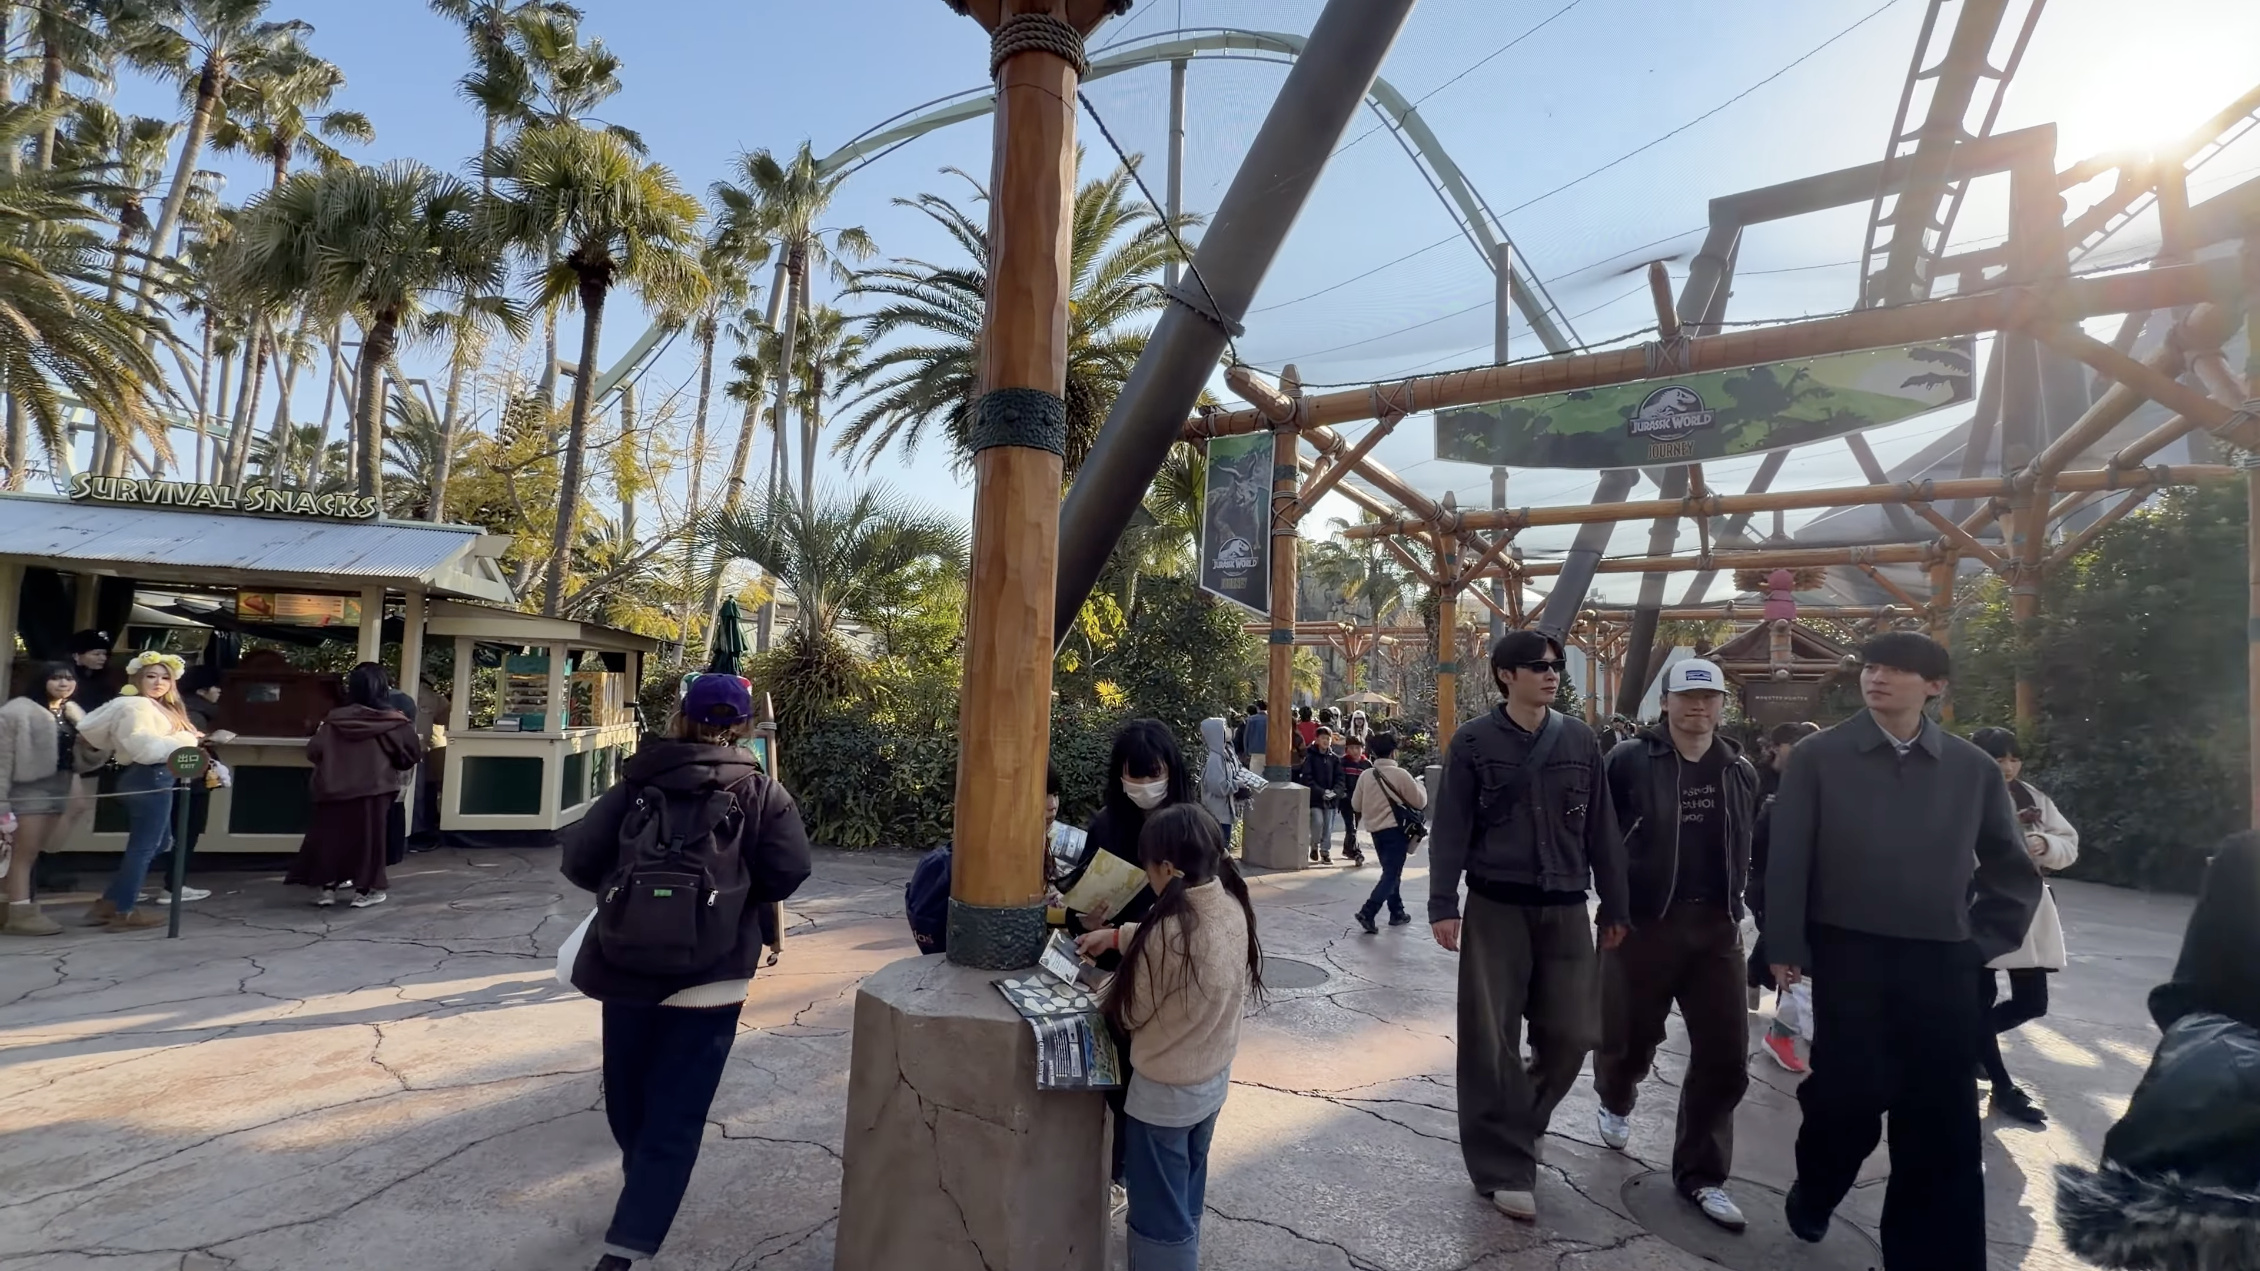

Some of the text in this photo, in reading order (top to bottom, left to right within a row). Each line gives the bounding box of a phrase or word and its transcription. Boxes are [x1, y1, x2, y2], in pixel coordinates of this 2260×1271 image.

[1631, 413, 1712, 434] JURASSIC WORLD
[1648, 441, 1695, 459] JOURNEY
[70, 471, 378, 519] SURVIVAL SNACKS
[1235, 558, 1258, 568] WORLD
[177, 754, 200, 763] 出口
